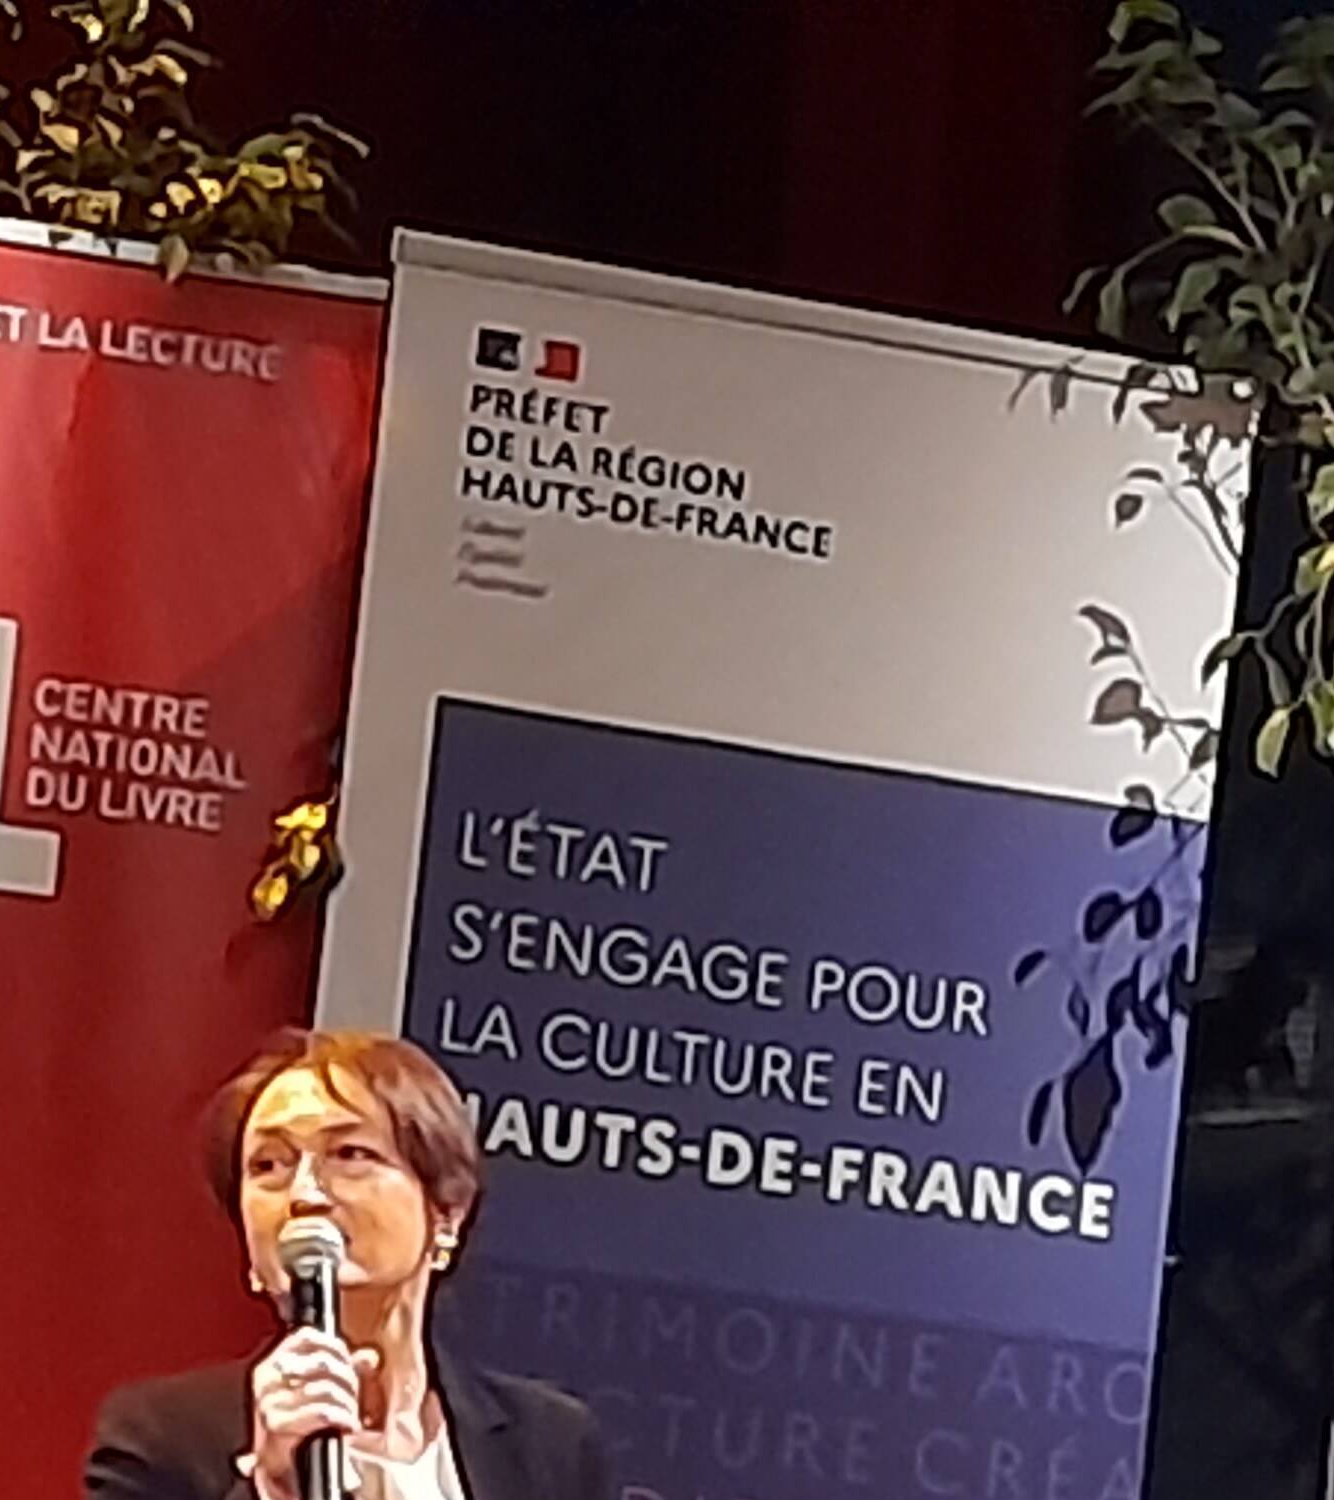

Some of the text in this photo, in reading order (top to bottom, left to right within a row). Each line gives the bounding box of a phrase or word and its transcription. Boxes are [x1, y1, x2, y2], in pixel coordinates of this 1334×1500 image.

[38, 312, 88, 351] LA
[101, 320, 283, 381] LECTURE
[470, 383, 610, 434] PRÉFET
[465, 425, 746, 501] DE LA RÉGION
[462, 467, 833, 558] HAUTS-DE-FRANCE
[34, 678, 210, 738] CENTRE
[30, 722, 248, 789] NATIONAL
[26, 766, 223, 831] DU LIVRE
[460, 810, 667, 893] L'ÉTAT
[449, 903, 991, 1037] S'ENGAGE POUR
[439, 997, 947, 1123] LA CULTURE EN
